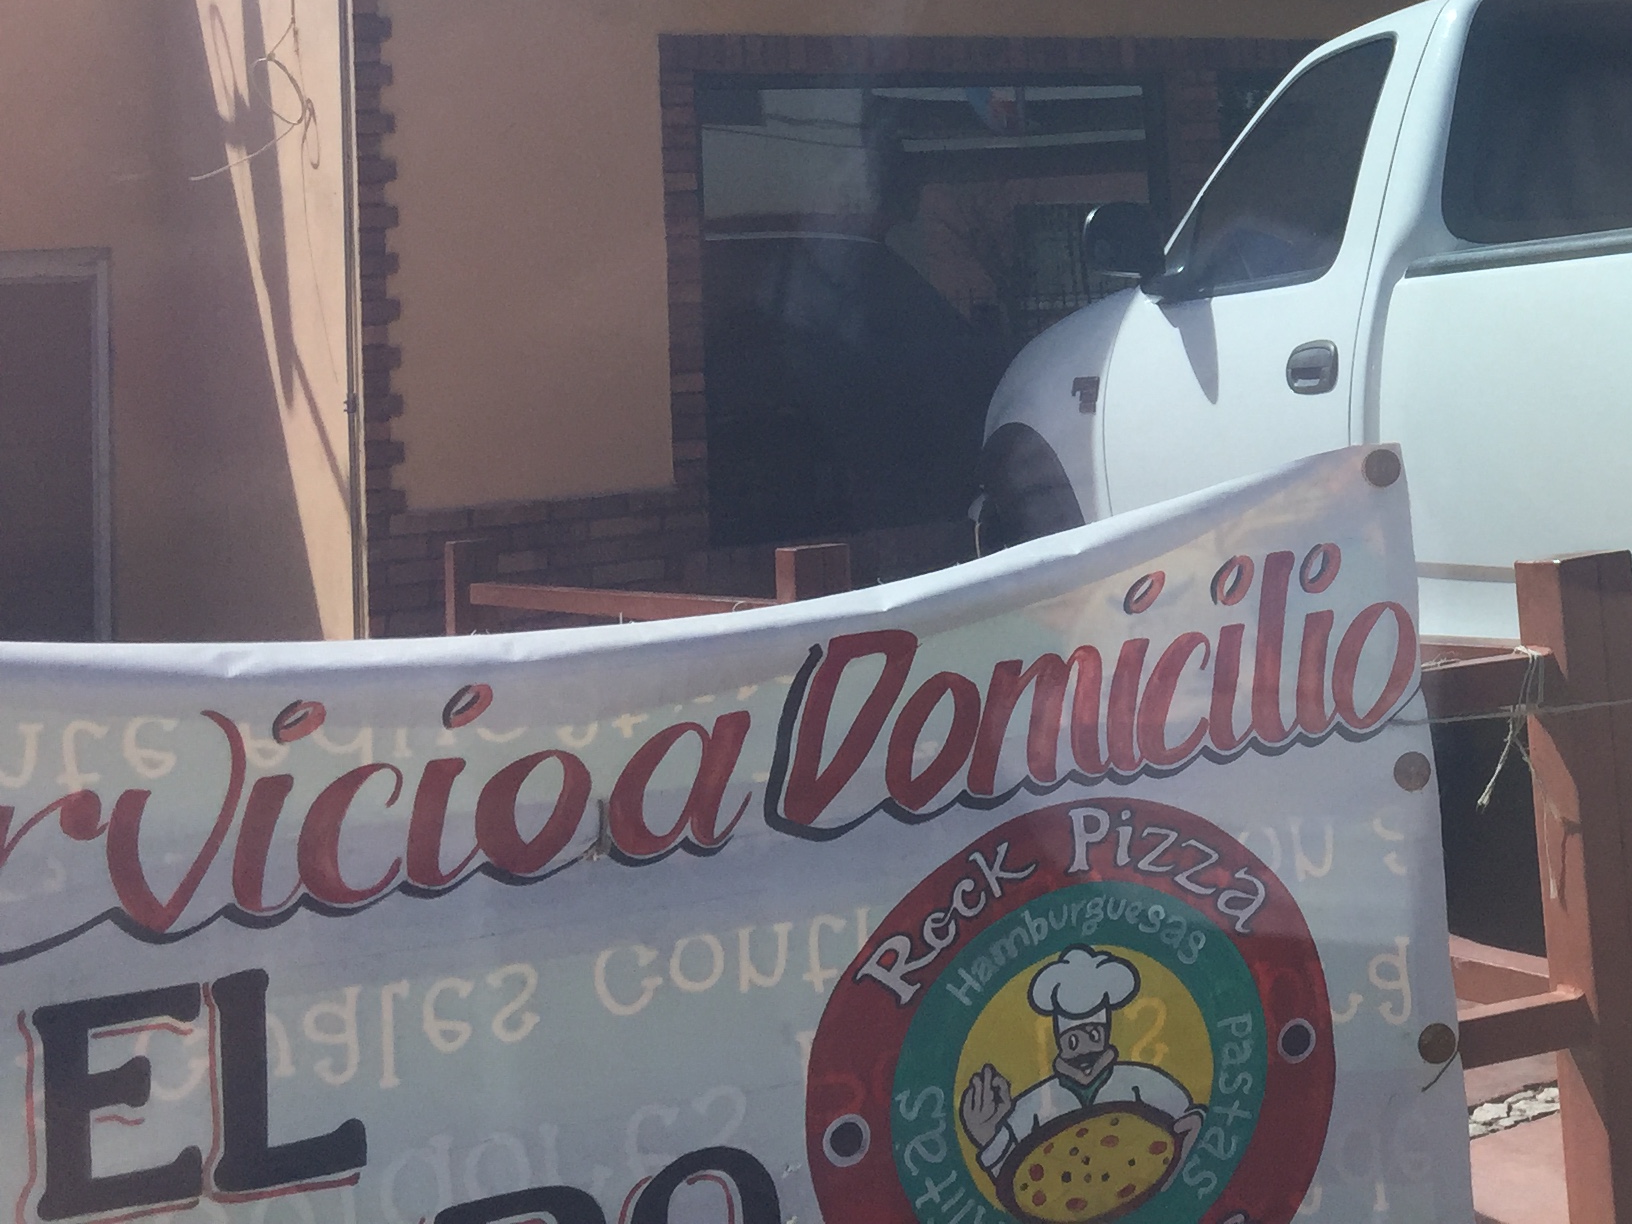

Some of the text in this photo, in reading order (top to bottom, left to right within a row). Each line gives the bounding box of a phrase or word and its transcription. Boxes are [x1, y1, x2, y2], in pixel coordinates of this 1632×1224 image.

[766, 542, 1420, 840] Domicilio
[855, 806, 1271, 1006] Rock Pizza
[946, 893, 1210, 1008] Hamburguesas
[20, 967, 369, 1222] EL
